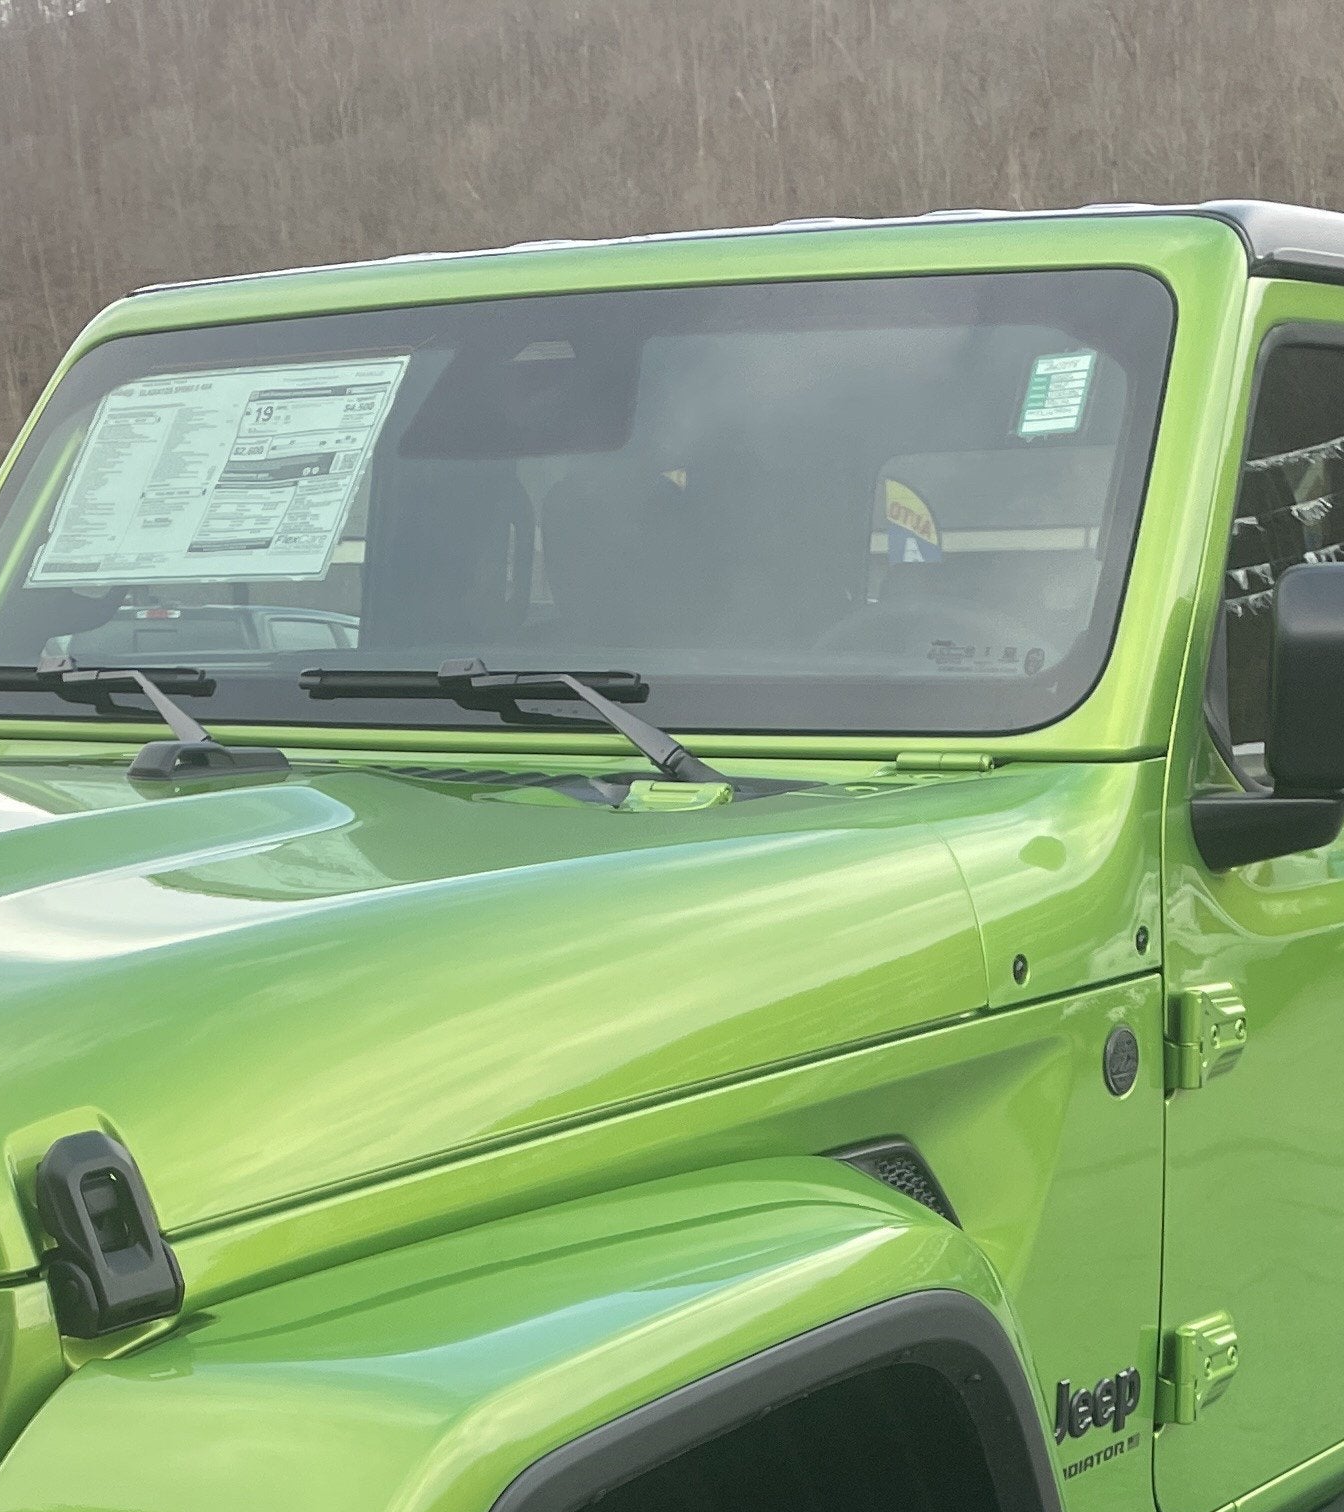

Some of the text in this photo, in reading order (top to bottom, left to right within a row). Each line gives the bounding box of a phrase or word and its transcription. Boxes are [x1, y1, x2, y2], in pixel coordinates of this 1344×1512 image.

[255, 406, 274, 422] 19
[1054, 1366, 1142, 1446] Jeep
[1063, 1444, 1125, 1481] DIATOR
